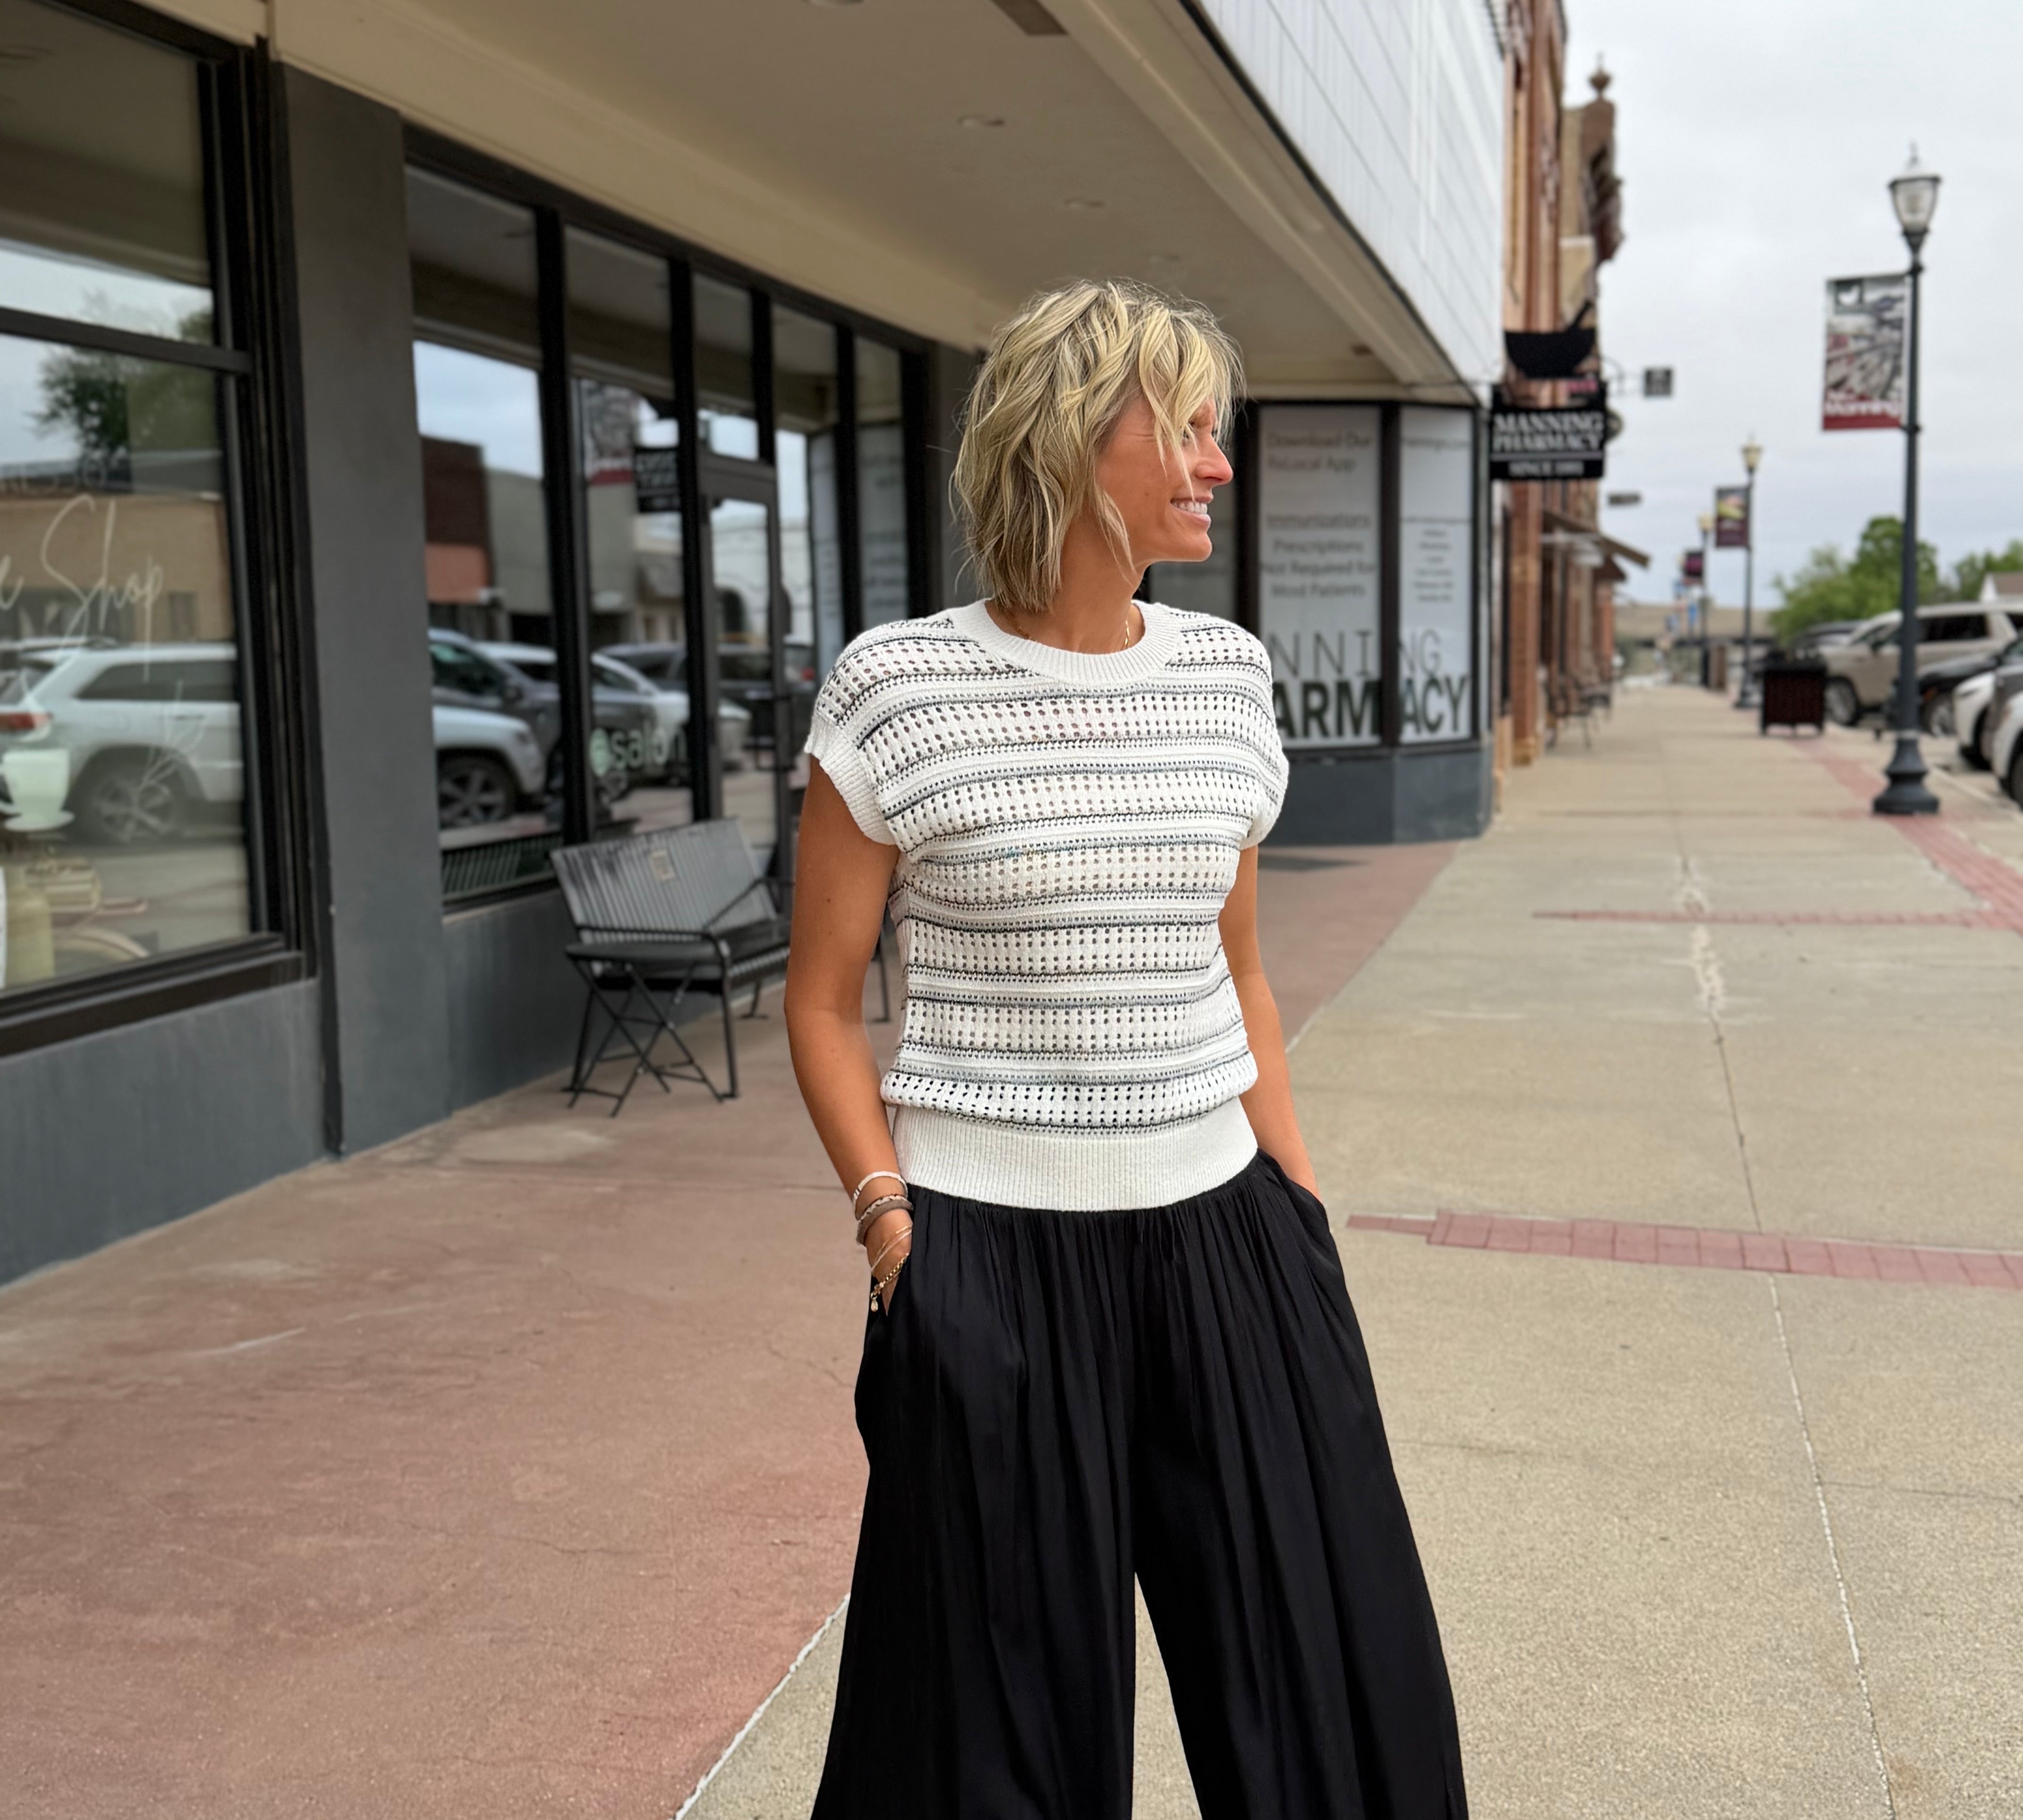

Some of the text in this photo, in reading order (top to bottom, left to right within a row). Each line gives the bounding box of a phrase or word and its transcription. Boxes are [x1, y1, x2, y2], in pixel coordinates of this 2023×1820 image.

[1493, 411, 1604, 433] MANNING
[1493, 432, 1601, 453] PHARMACY
[33, 494, 164, 689] Shop
